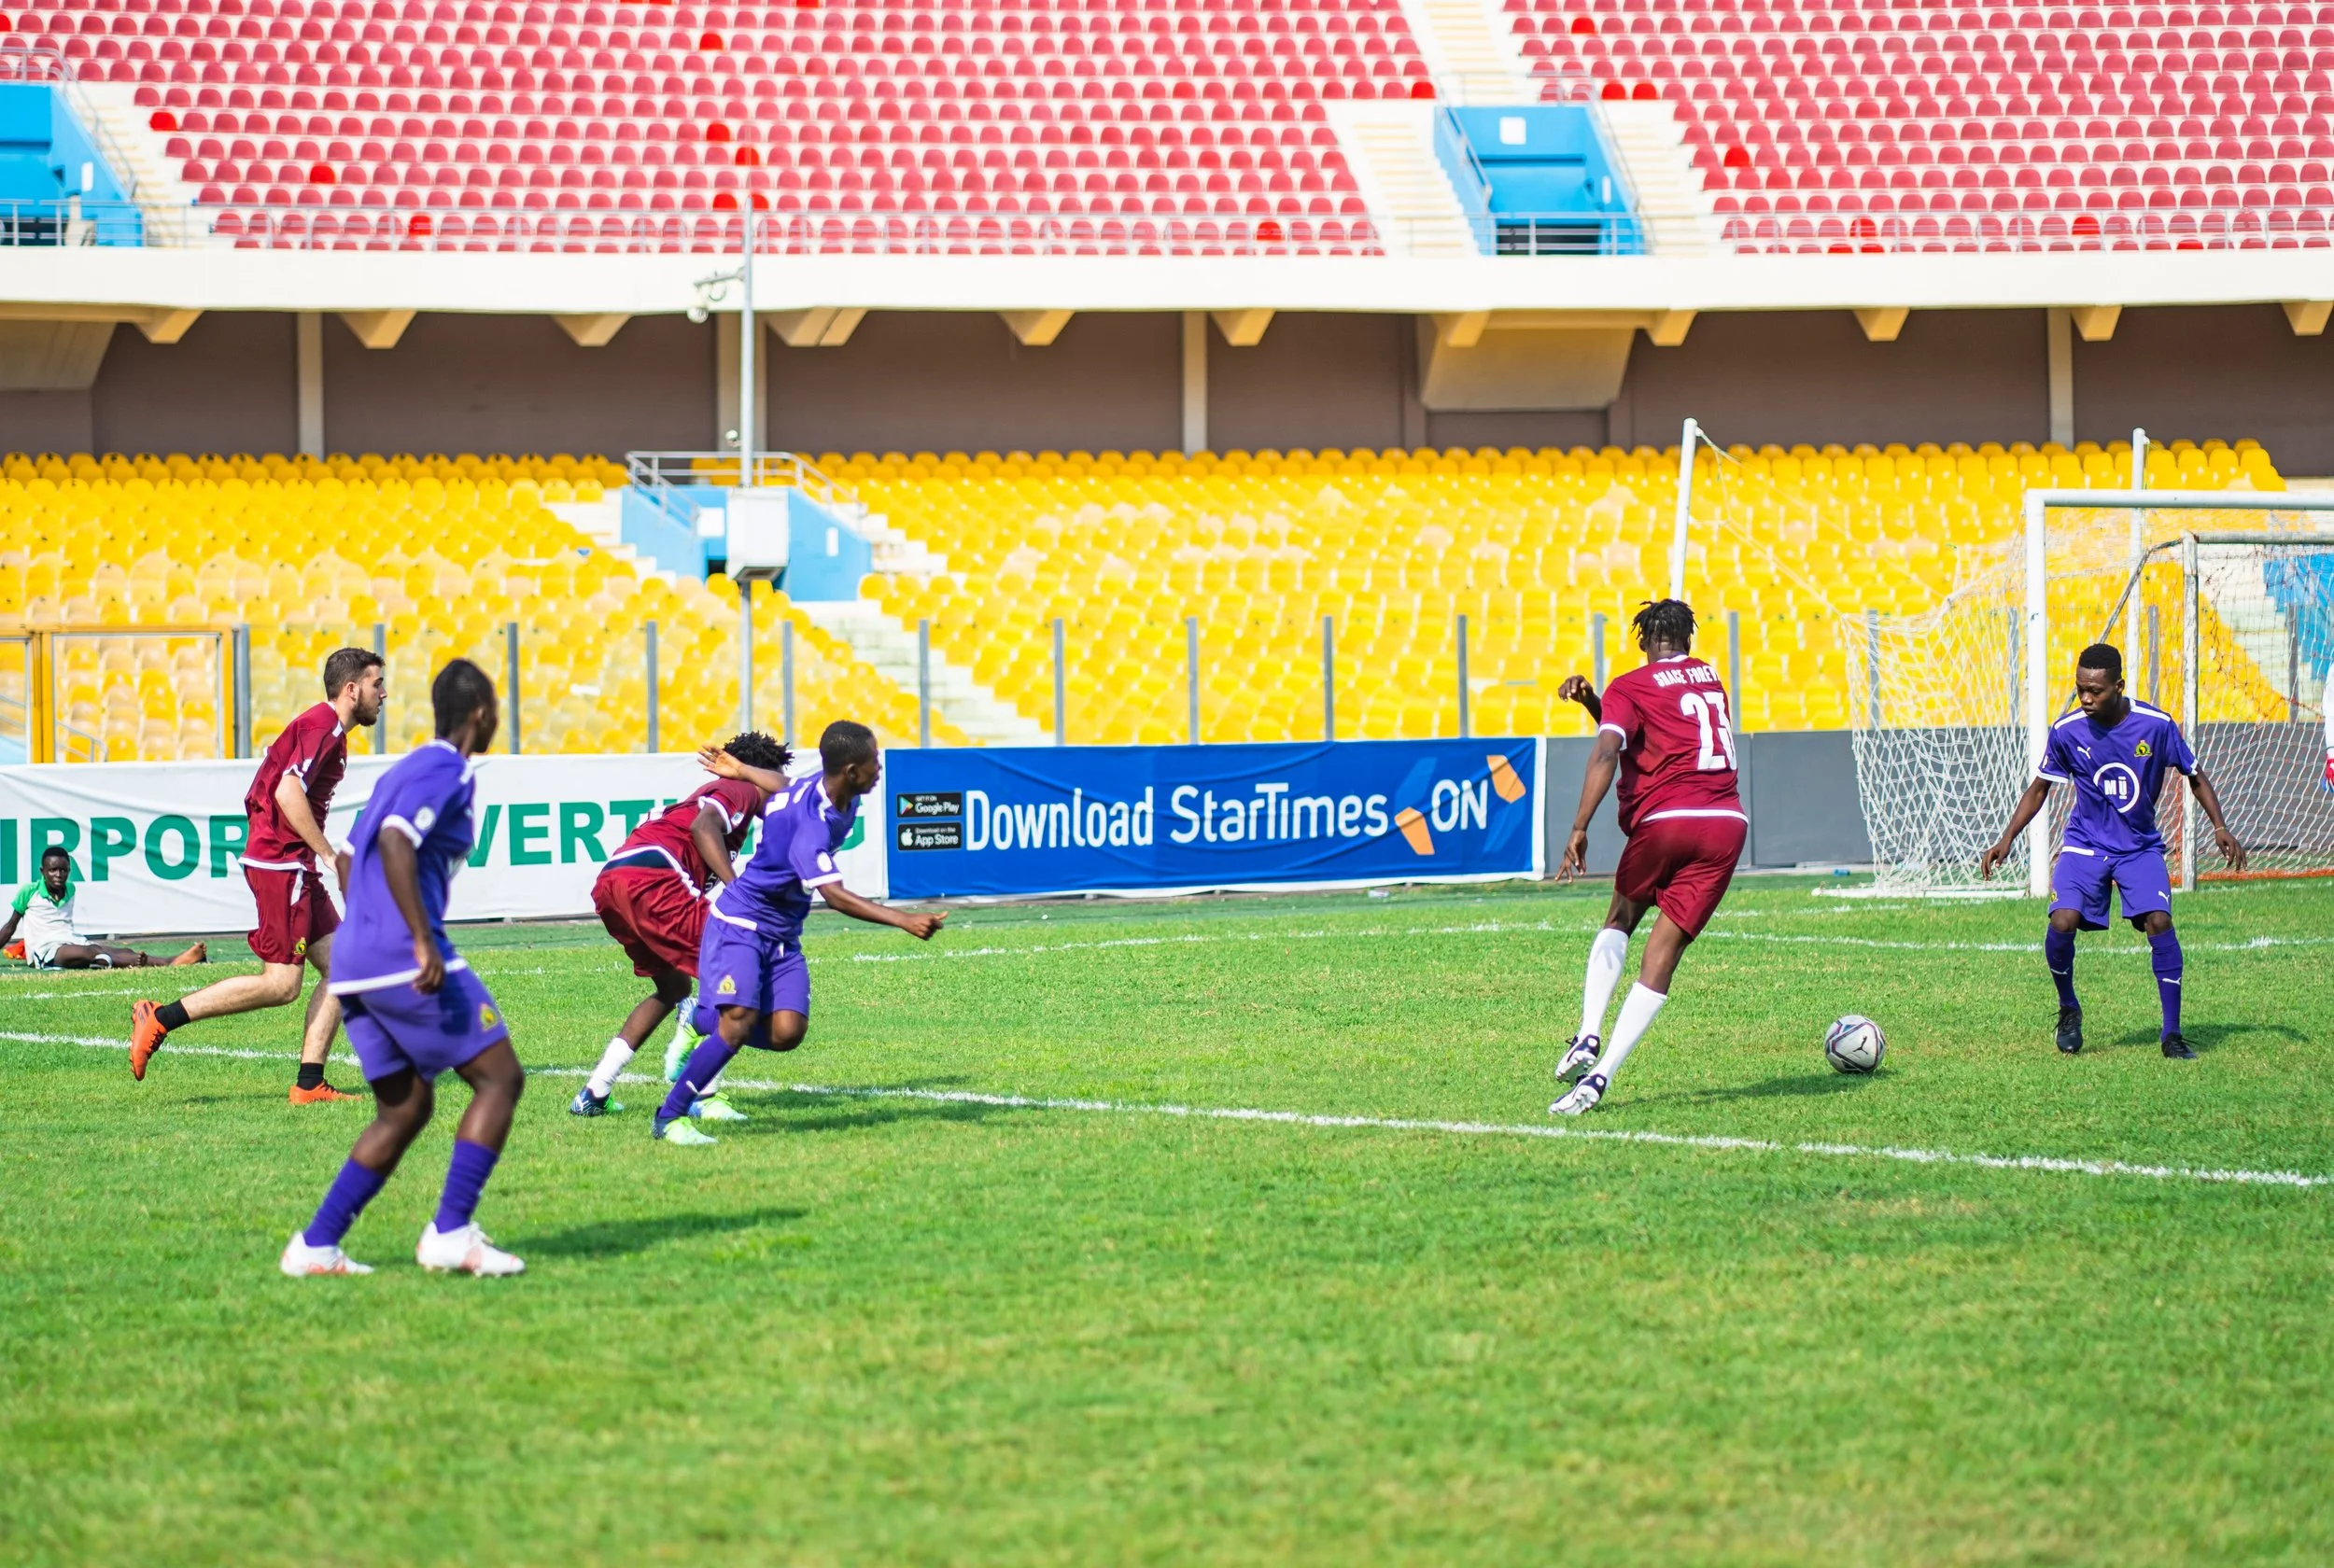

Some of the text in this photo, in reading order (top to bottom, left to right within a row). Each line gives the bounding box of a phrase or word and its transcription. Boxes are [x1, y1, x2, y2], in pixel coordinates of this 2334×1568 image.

[1680, 692, 1737, 770] 23
[915, 802, 960, 815] Google Play
[915, 833, 958, 847] App Store
[965, 779, 1488, 850] Download StarTimes ON
[0, 815, 249, 884] IRPOR
